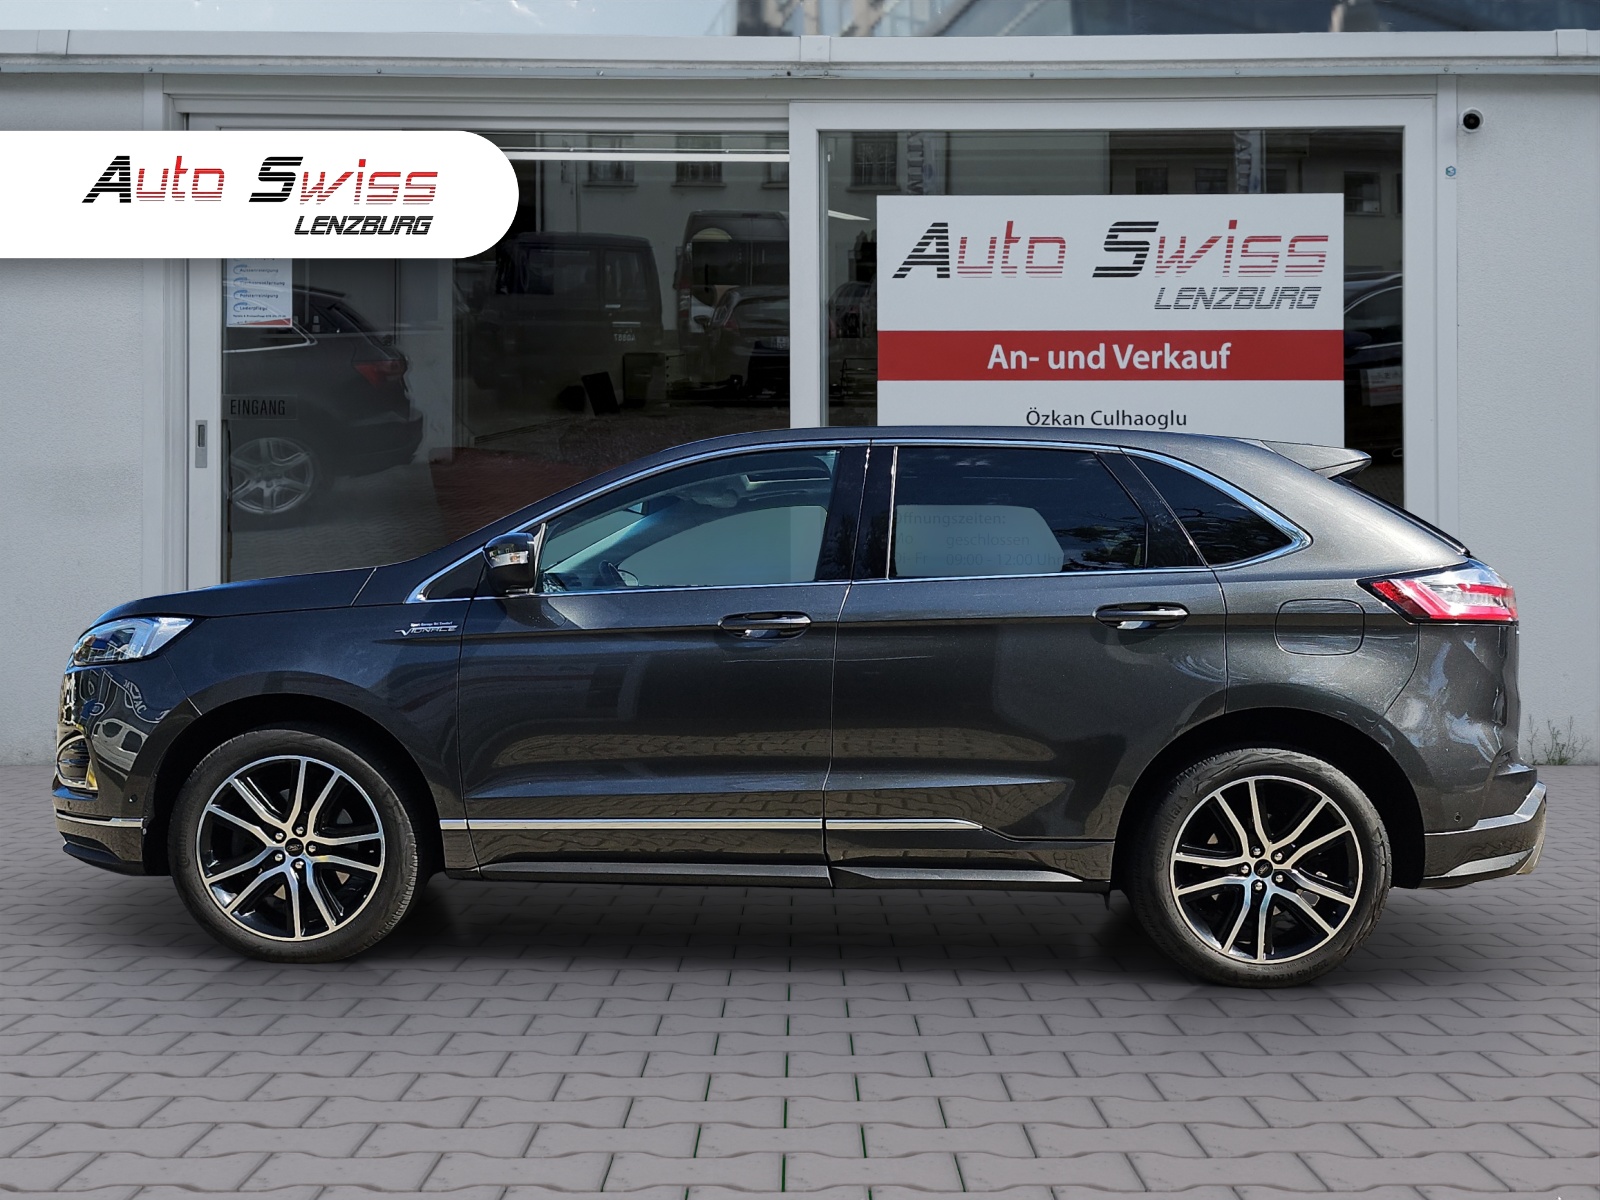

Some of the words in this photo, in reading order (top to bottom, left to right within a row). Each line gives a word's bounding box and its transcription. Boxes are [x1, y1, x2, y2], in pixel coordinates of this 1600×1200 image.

[892, 220, 1066, 279] Auto
[1092, 219, 1329, 279] Swiss
[1154, 286, 1322, 310] LENZBURG
[987, 343, 1040, 370] An-
[1048, 343, 1106, 370] und
[1112, 343, 1232, 370] Verkauf
[230, 399, 286, 416] EINGANG
[1026, 407, 1085, 426] Özkan
[1090, 409, 1188, 430] Culhaoglu
[946, 533, 1031, 547] geschlossen
[946, 553, 984, 566] 09:00
[998, 553, 1033, 566] 12:00
